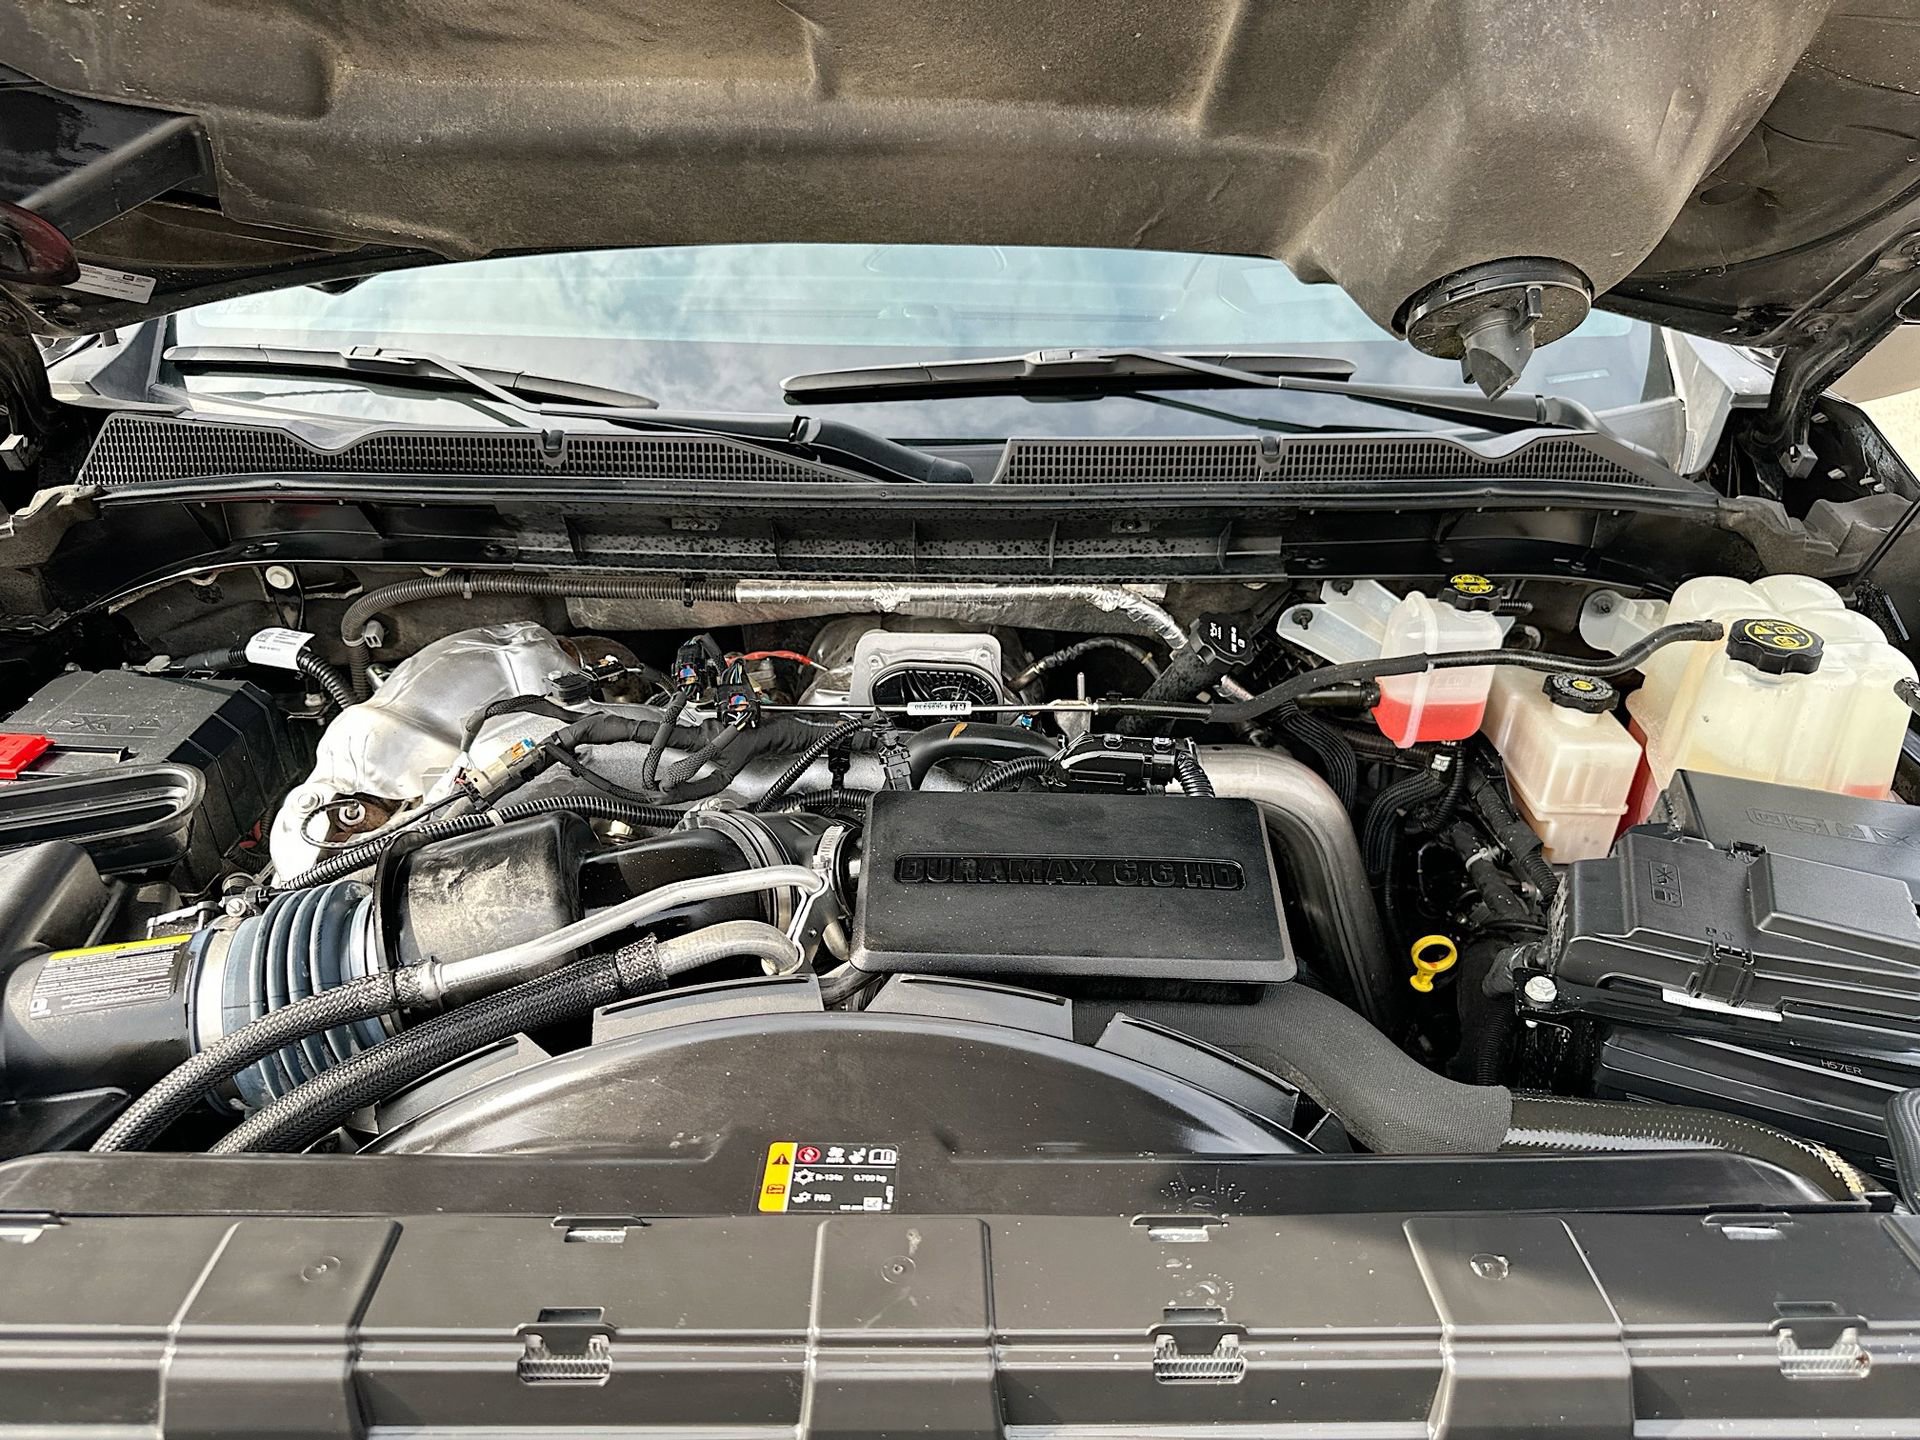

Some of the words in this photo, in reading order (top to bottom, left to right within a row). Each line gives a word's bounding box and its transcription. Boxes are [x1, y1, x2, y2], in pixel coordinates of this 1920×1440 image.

[899, 856, 1098, 886] DURAMAX
[1112, 861, 1177, 888] 6.6
[1184, 864, 1239, 889] HD
